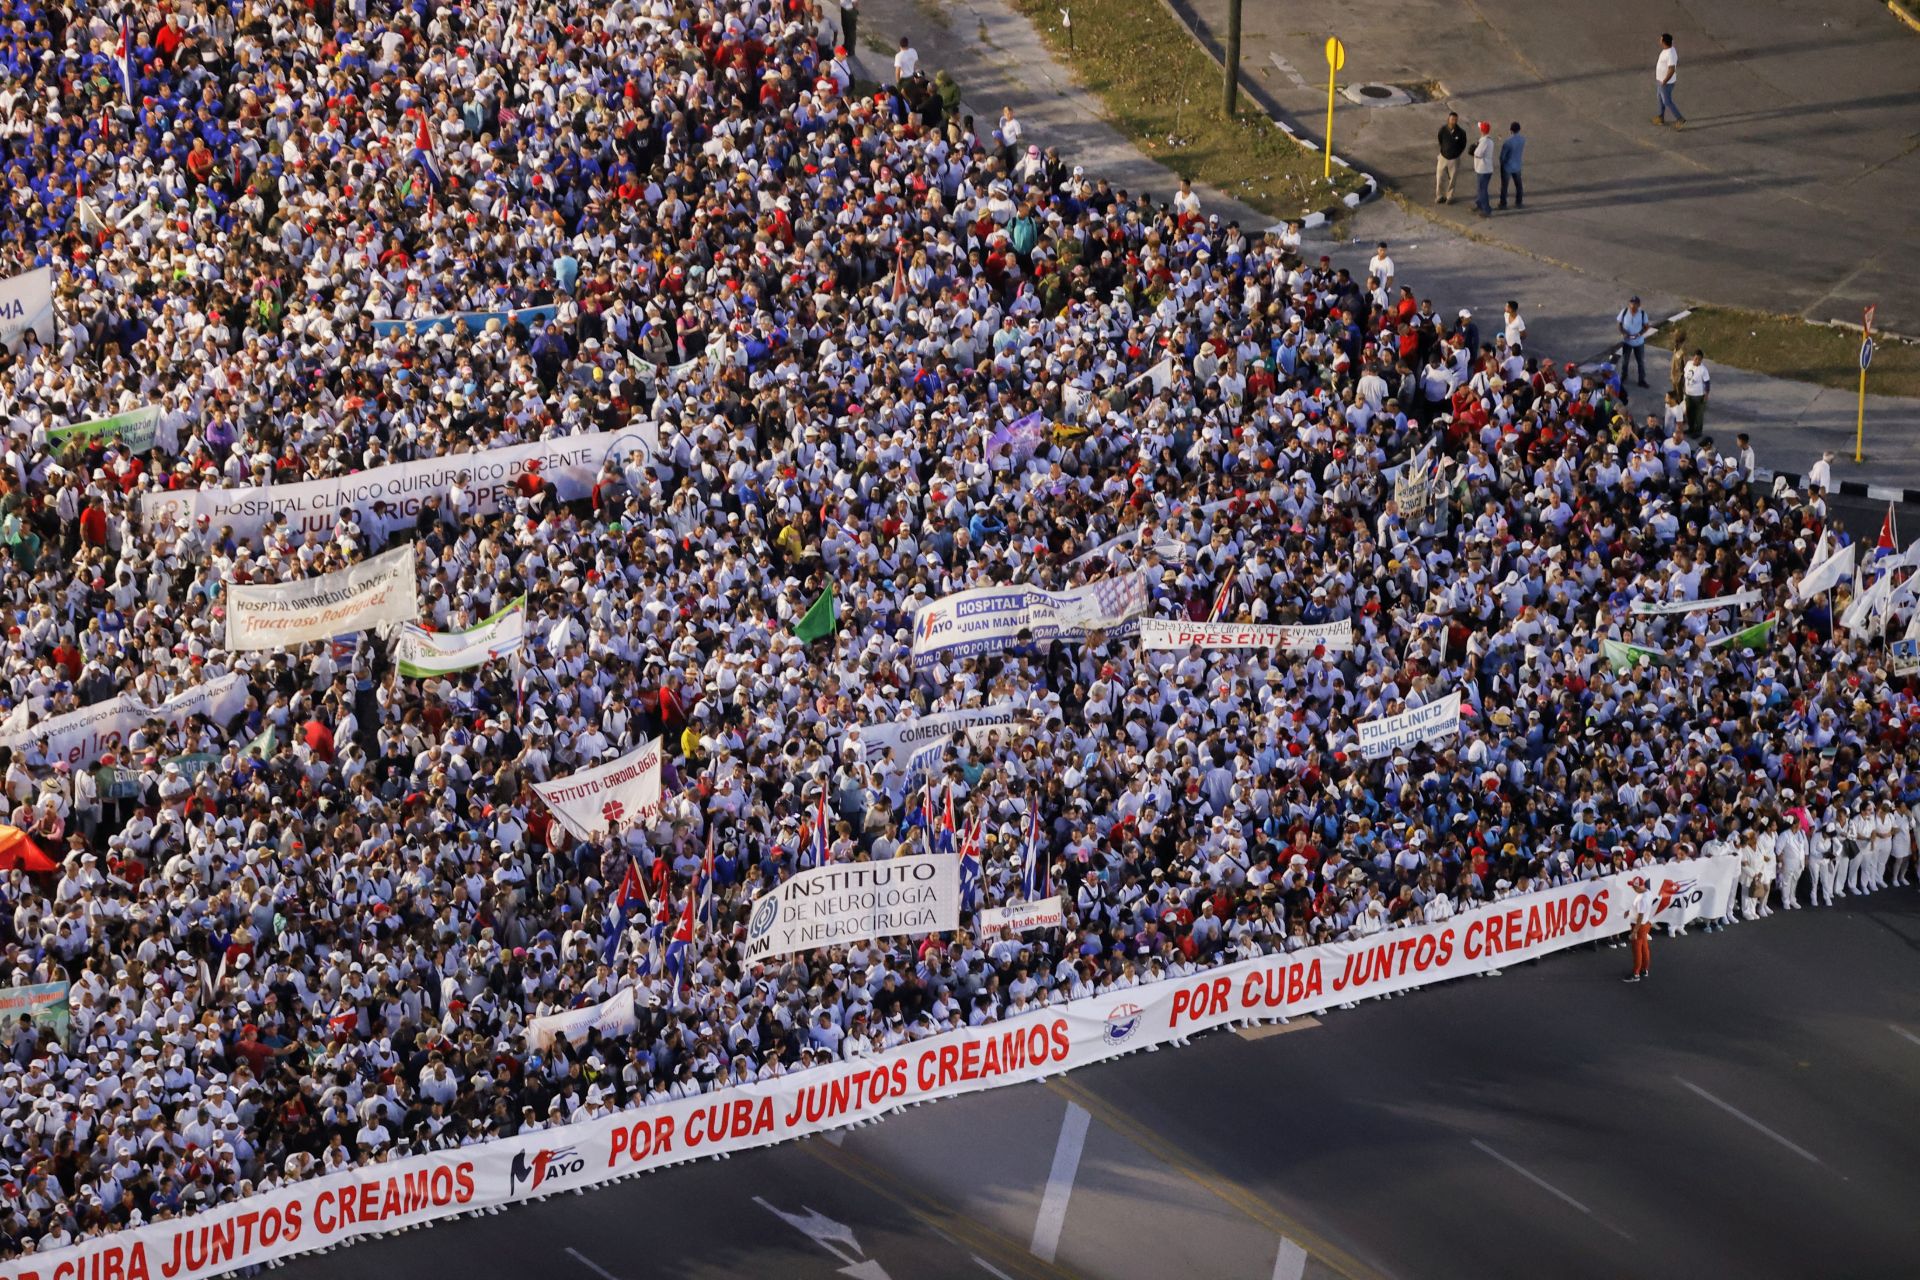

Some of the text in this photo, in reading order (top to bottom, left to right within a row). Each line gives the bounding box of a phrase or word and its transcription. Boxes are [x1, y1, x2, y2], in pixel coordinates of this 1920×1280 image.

[214, 498, 306, 516] HOSPITAL
[312, 481, 383, 509] CLÍNICO
[510, 448, 592, 475] DOCENTE
[296, 509, 362, 535] JULO
[369, 496, 432, 520] RIG
[237, 600, 291, 612] HOSPITAL
[292, 586, 357, 611] ORTOPÉDICO
[959, 598, 1019, 615] HOSPITAL
[993, 614, 1030, 629] MANUE
[972, 640, 989, 654] POR
[992, 639, 1002, 651] LA
[900, 712, 1018, 743] COMERCIALIZADORA
[1362, 704, 1442, 740] POLICLINICO
[603, 751, 658, 789] CARDIOLOGÍA
[785, 863, 936, 900] INSTITUTO
[784, 884, 937, 923] DE NEUROLOGÍA
[1025, 916, 1035, 926] de
[783, 905, 937, 945] Y NEUROCIRUGÍA
[745, 936, 770, 960] INN
[1168, 976, 1232, 1028] POR
[1241, 958, 1323, 1009] CUBA
[1332, 927, 1454, 991] JUNTOS
[1464, 888, 1609, 961] CREAMOS
[608, 1115, 675, 1168] POR
[684, 1095, 775, 1147] CUBA
[785, 1058, 907, 1128] JUNTOS
[917, 1018, 1070, 1091] CREAMOS
[161, 1199, 302, 1279] JUNTOS
[313, 1161, 475, 1235] CREAMOS
